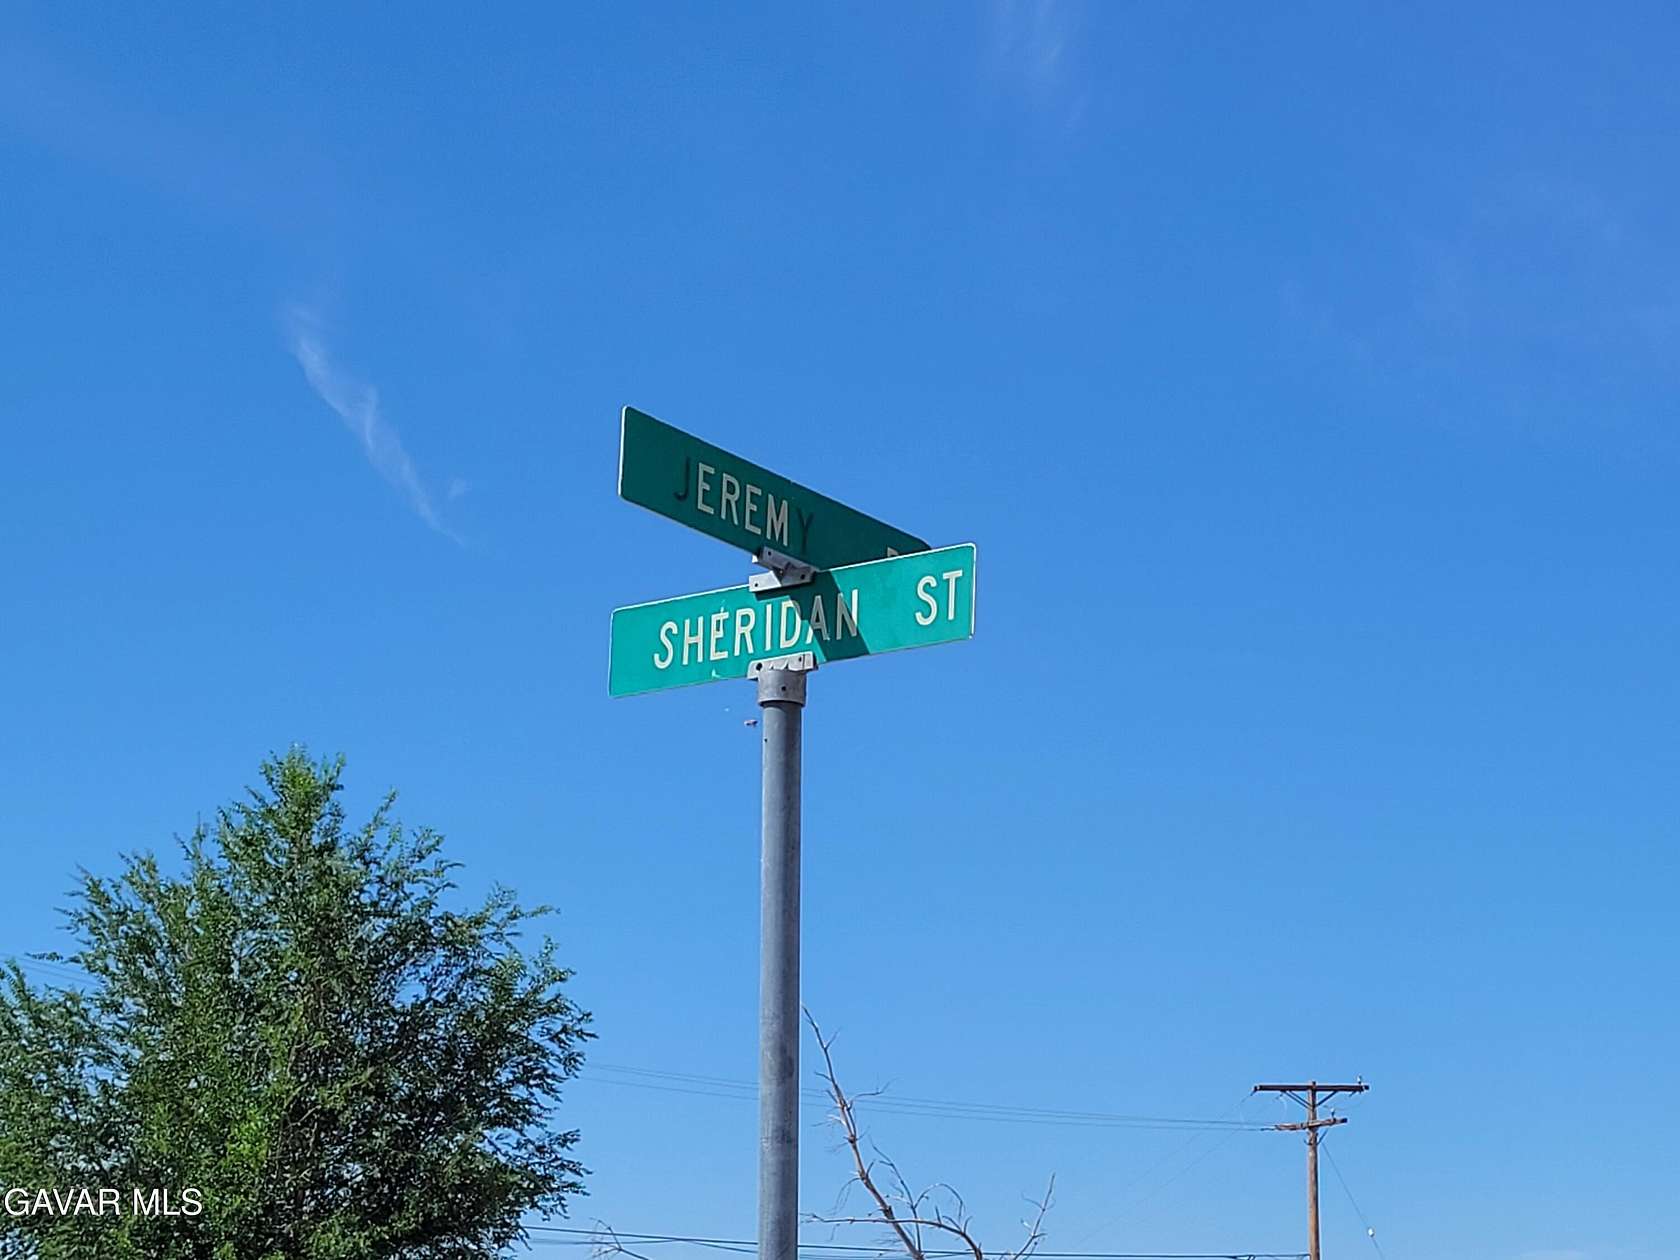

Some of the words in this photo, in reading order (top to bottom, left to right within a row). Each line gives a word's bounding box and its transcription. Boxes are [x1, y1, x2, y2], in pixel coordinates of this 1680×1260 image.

[673, 456, 814, 554] JEREMY
[653, 589, 859, 669] SHERIDAN
[915, 569, 963, 626] ST
